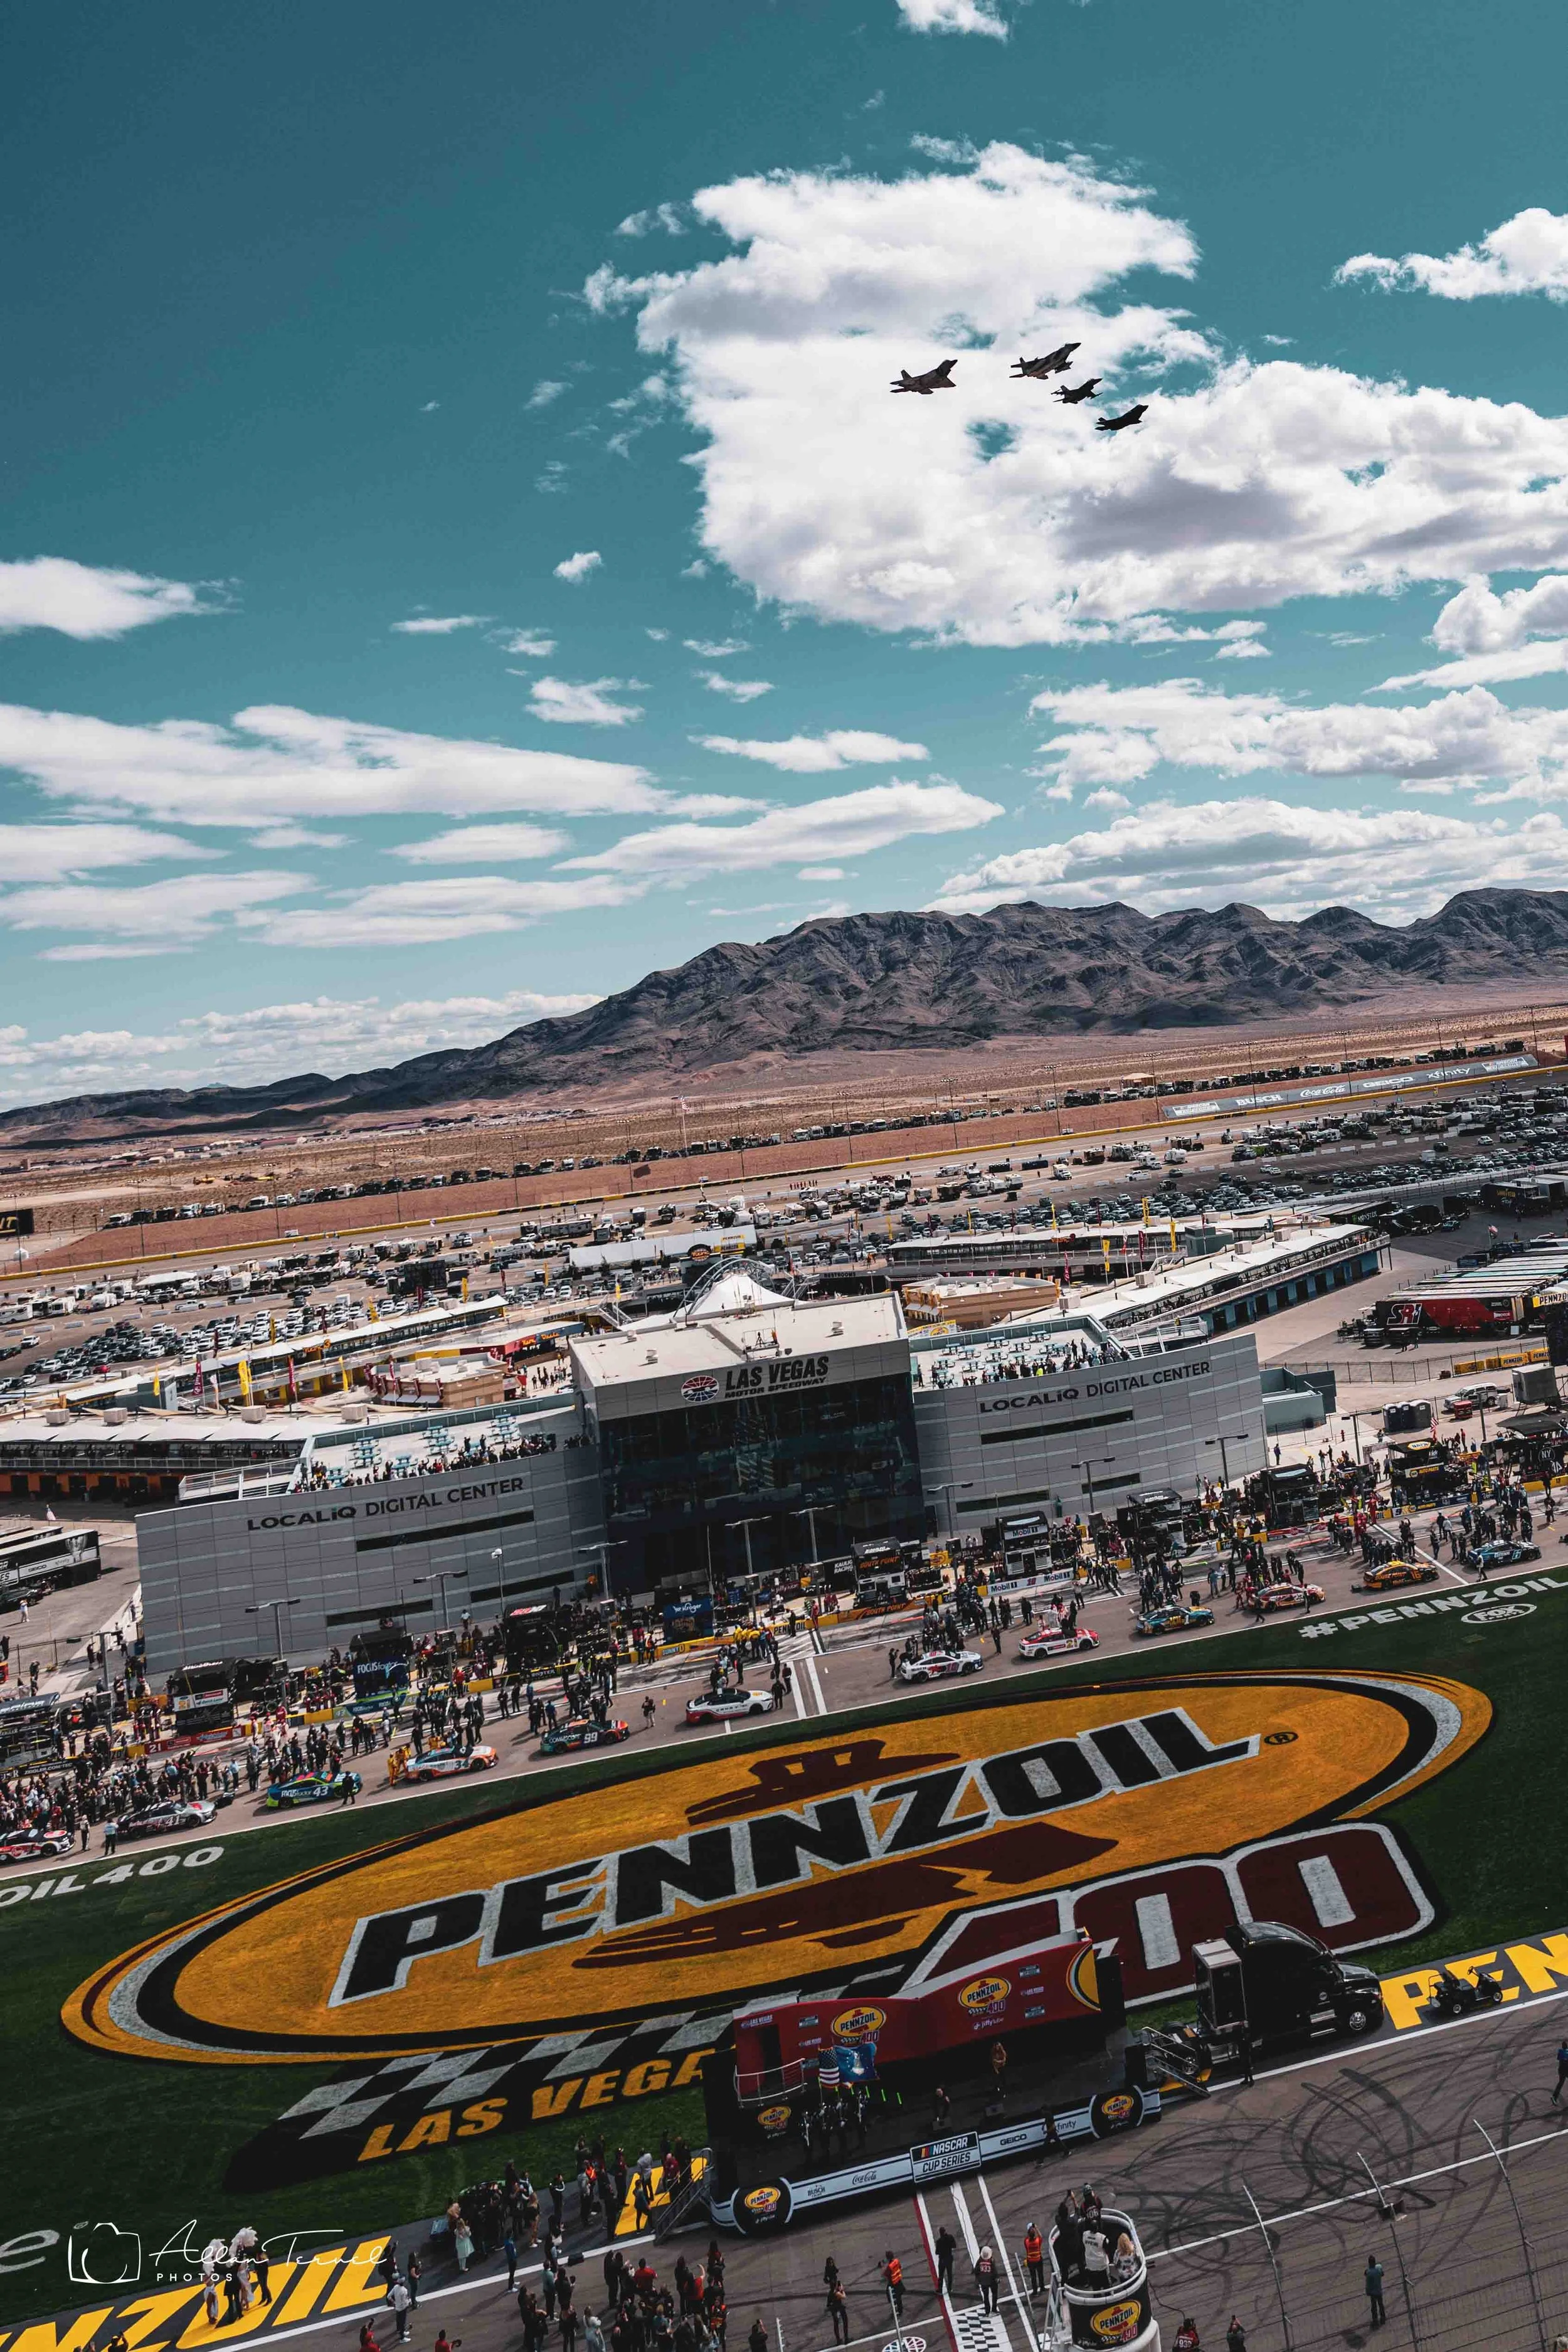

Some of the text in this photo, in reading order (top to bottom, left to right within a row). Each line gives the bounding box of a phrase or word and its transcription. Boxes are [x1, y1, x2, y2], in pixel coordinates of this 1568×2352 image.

[1426, 1067, 1470, 1079] xfinity
[1362, 1076, 1414, 1088] GEICO
[1300, 1084, 1346, 1098] Coca-Cola
[1236, 1094, 1283, 1106] BUSCH
[1358, 1210, 1378, 1222] MONSTER
[543, 1310, 576, 1322] RESTROOMS
[726, 1356, 829, 1391] LAS VEGAS
[1086, 1374, 1150, 1397] DIGITAL
[1152, 1361, 1210, 1384] CENTER
[724, 1377, 826, 1399] MOTOR SPEEDWAY
[366, 1493, 442, 1517] DIGITAL
[447, 1476, 524, 1503] CENTER
[1013, 1528, 1031, 1537] Mobil
[880, 1556, 900, 1564] POINT
[1044, 1573, 1063, 1582] Mobil
[1411, 1568, 1421, 1580] 16
[991, 1583, 1010, 1592] Mobil
[867, 1603, 906, 1616] SOUTH POINT
[1298, 1577, 1568, 1638] #PENNZOIL
[1473, 1606, 1517, 1621] FOX
[774, 1621, 806, 1635] PENOIL
[584, 1732, 598, 1744] 99
[149, 1744, 162, 1753] 21
[314, 1786, 328, 1797] 43
[166, 1814, 180, 1826] 41
[327, 1706, 1262, 2008] PENNZOIL
[93, 1846, 225, 1884] 400
[967, 1982, 1002, 2003] PENNZOIL
[840, 2012, 877, 2032] PENNZOIL
[358, 2048, 704, 2163] LAS VEGA
[1106, 2099, 1128, 2113] PENNZOIL
[933, 2136, 968, 2156] NASCAR
[1000, 2134, 1027, 2146] GEICO
[923, 2152, 972, 2173] CUP SERIES
[852, 2170, 877, 2185] Coca-Cola
[750, 2191, 773, 2205] PENNZOIL
[807, 2186, 825, 2197] BUSCH
[0, 2235, 393, 2352] NZOIL
[1099, 2306, 1135, 2329] PENNZOIL
[1120, 2323, 1138, 2343] 400
